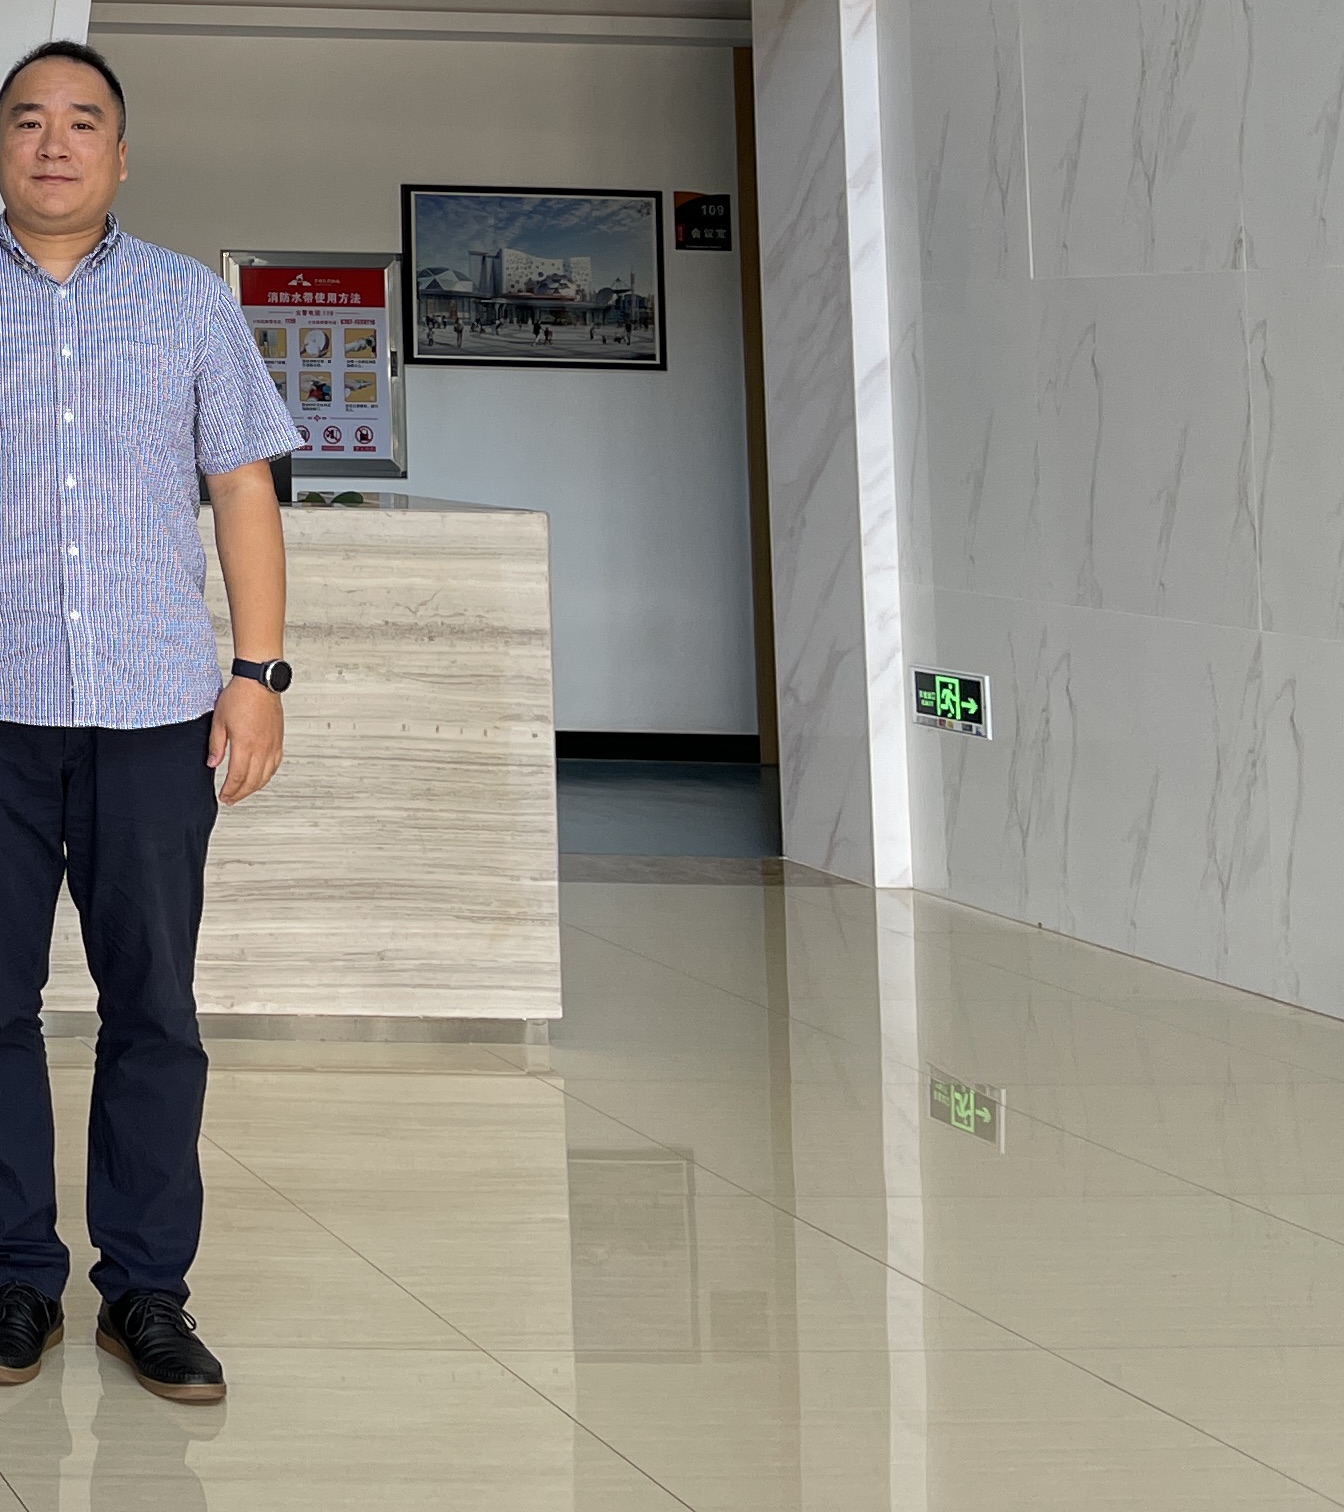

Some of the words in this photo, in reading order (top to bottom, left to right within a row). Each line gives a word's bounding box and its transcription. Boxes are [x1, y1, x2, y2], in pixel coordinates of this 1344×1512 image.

[267, 291, 362, 305] 消防水带使用方法
